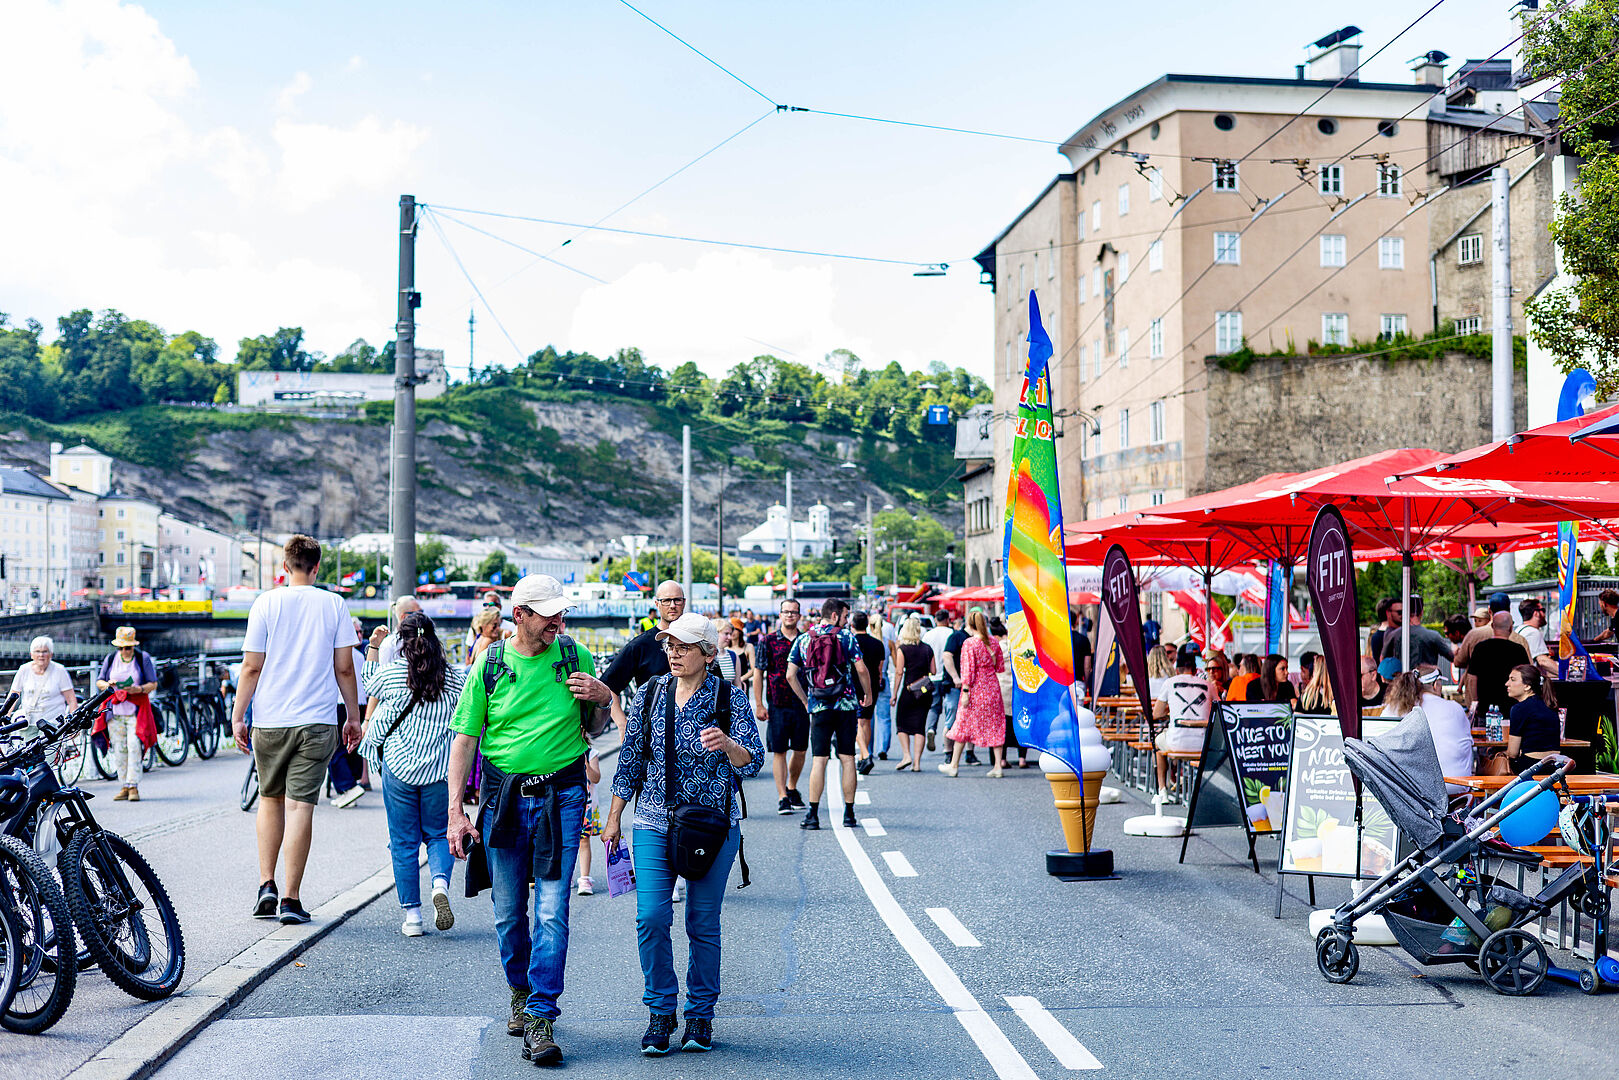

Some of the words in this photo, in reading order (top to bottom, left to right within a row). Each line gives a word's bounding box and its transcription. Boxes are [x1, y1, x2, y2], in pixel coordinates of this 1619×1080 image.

[1320, 549, 1344, 592] FIT.
[1110, 570, 1129, 604] FIT.
[1236, 726, 1265, 744] NICE
[1265, 725, 1286, 741] TO
[1236, 744, 1266, 760] MEET
[1301, 768, 1351, 786] MEET
